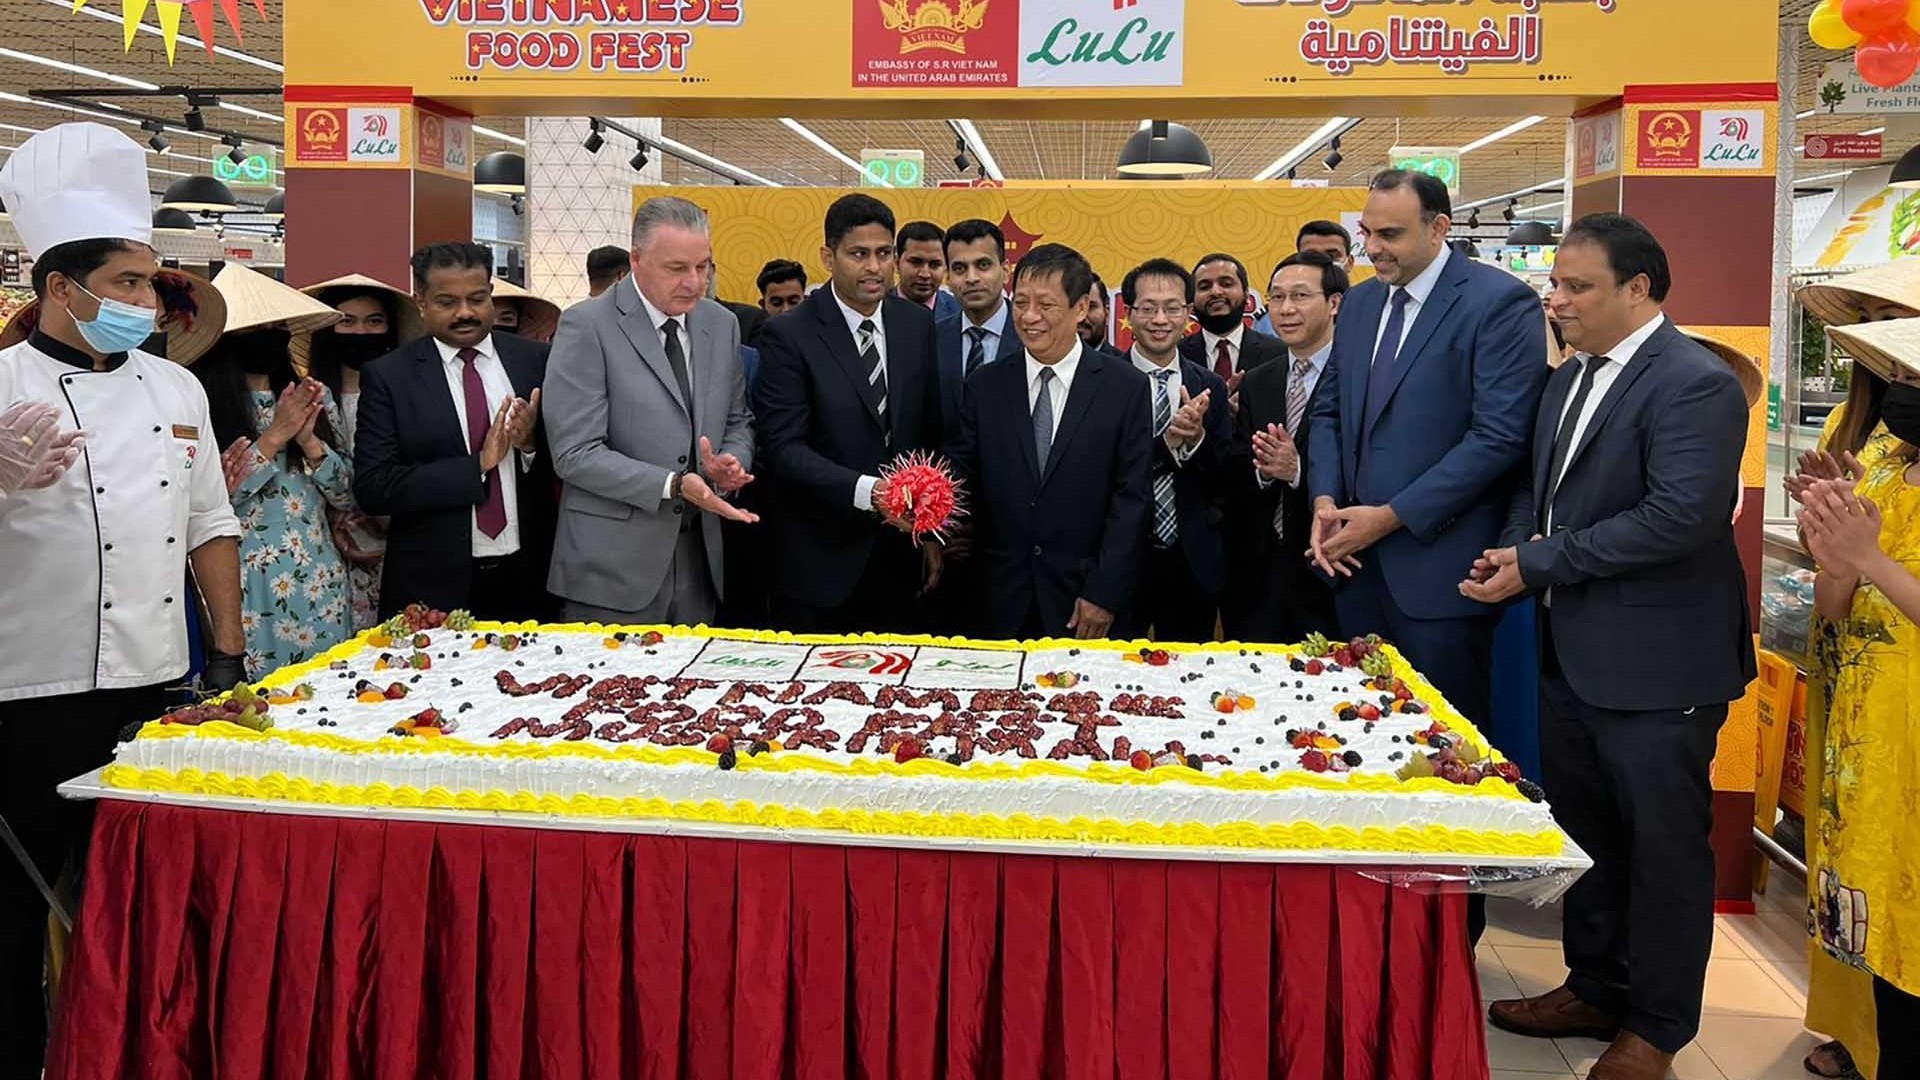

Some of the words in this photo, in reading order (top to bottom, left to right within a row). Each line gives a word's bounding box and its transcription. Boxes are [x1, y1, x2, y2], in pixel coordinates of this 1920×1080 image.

[418, 0, 744, 27] VIETNAMESE
[1026, 16, 1176, 66] LuLu
[1300, 14, 1543, 74] الفيتنامية
[467, 31, 580, 71] FOOD
[590, 31, 692, 72] FEST
[868, 60, 914, 70] EMBASSY
[917, 60, 930, 70] OF
[932, 60, 949, 70] S.R
[951, 60, 974, 70] VIET
[975, 60, 998, 69] NAM
[858, 73, 868, 82] IN
[871, 73, 889, 82] THE
[892, 73, 927, 82] UNITED
[929, 73, 957, 82] ARAB
[959, 73, 1008, 82] EMIRATES
[1851, 83, 1878, 93] Live
[1866, 97, 1902, 107] Fresh
[352, 138, 397, 155] LuLu
[1704, 143, 1760, 160] LuLu
